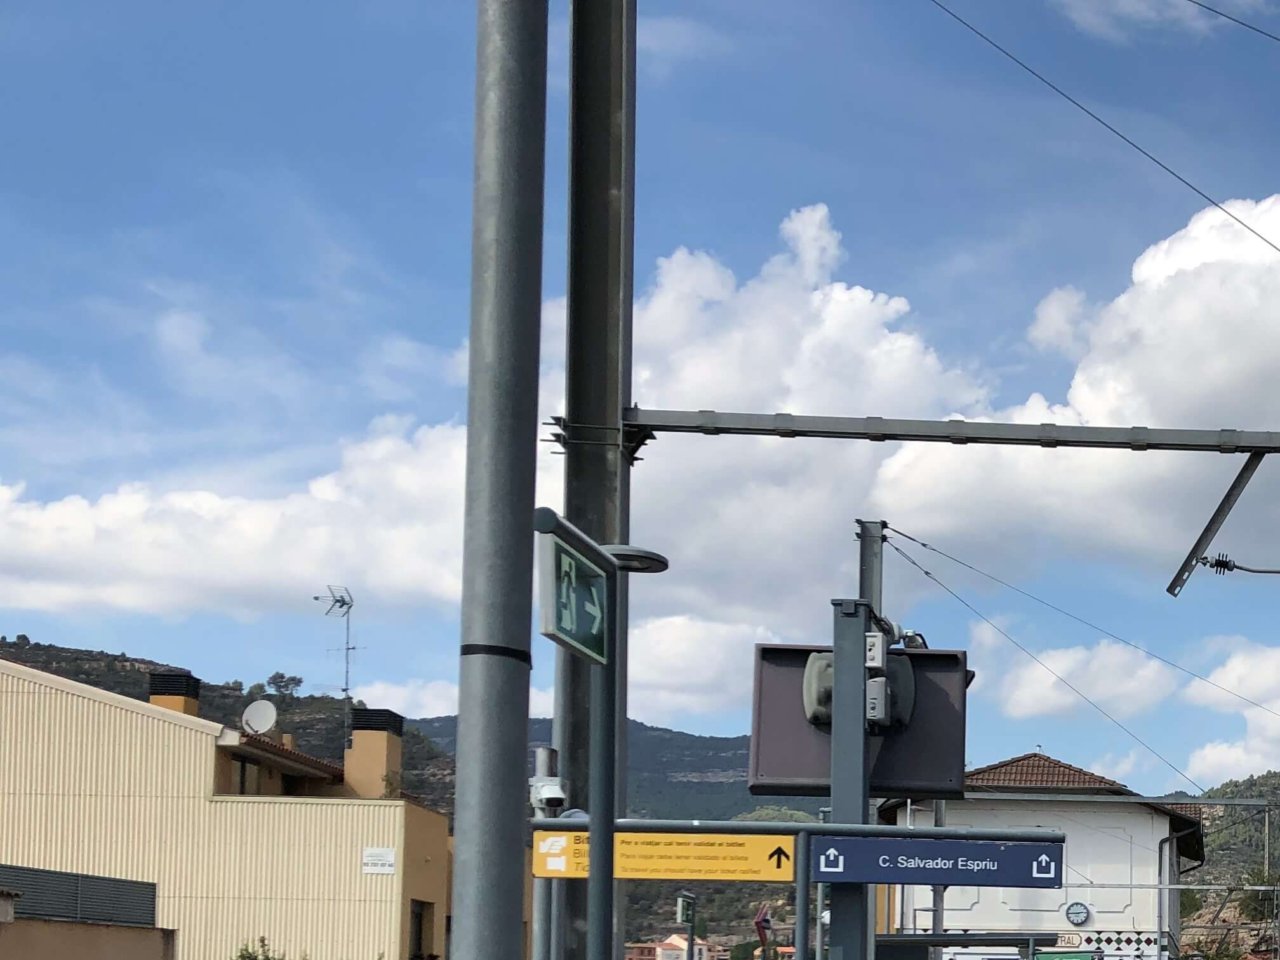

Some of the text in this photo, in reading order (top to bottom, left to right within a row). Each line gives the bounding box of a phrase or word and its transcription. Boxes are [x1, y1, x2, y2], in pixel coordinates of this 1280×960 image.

[878, 855, 998, 872] C. Salvador Espriu
